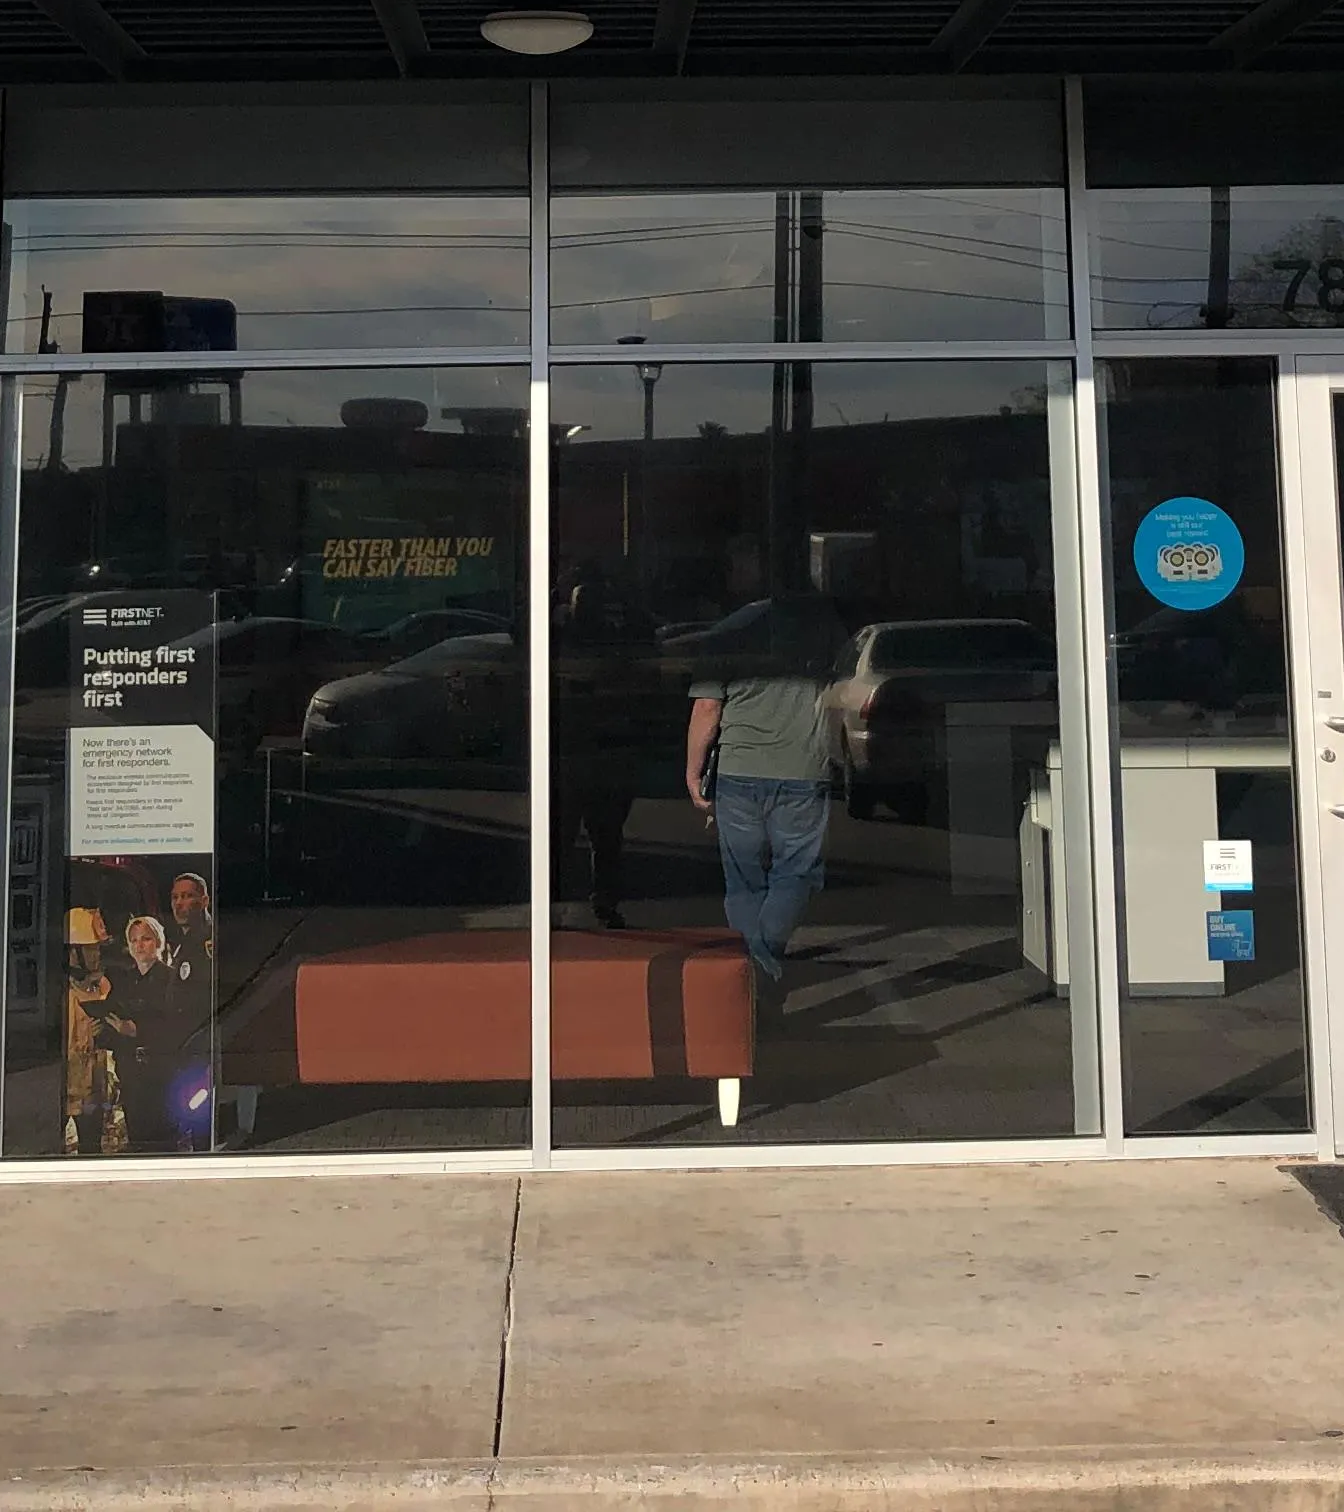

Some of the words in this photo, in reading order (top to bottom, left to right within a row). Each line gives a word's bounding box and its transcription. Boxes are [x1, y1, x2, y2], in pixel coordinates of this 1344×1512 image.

[323, 539, 393, 558] FASTER
[399, 538, 449, 557] THAN
[455, 537, 494, 556] YOU
[322, 558, 362, 577] CAN
[365, 558, 401, 577] SAY
[404, 557, 458, 576] FIBER
[83, 647, 152, 667] Putting
[156, 645, 196, 663] first
[83, 667, 188, 689] responders
[82, 689, 123, 707] first
[82, 738, 104, 747] Now
[106, 738, 137, 747] there's
[139, 738, 151, 746] an
[82, 749, 133, 759] emergency
[135, 747, 172, 756] network
[82, 759, 95, 768] for
[97, 759, 115, 768] first
